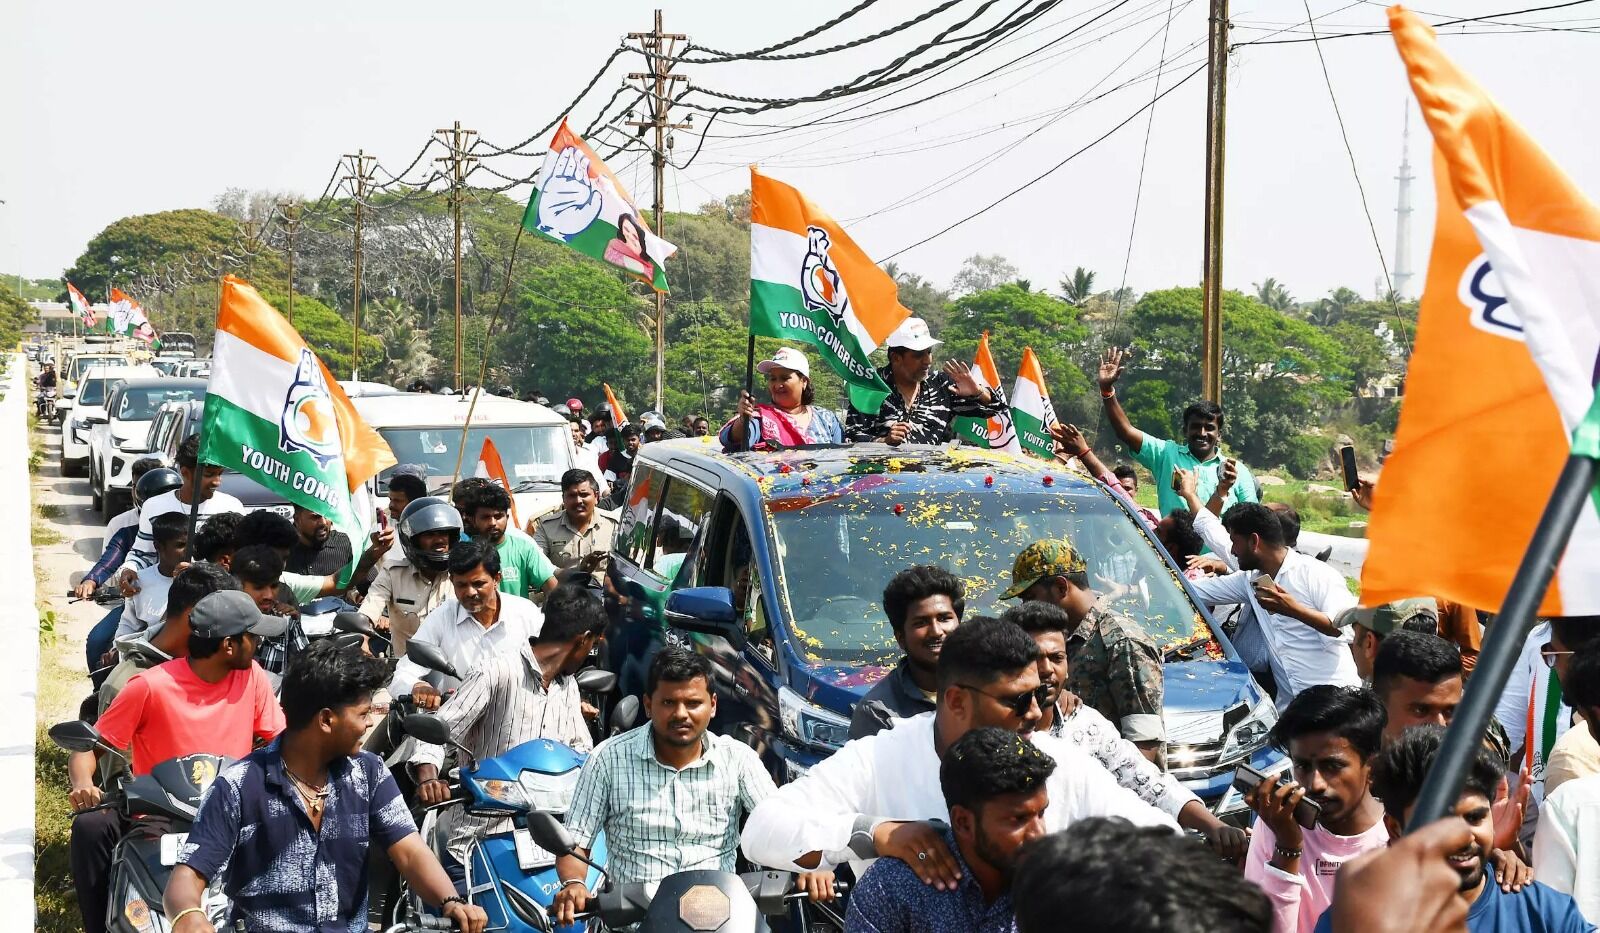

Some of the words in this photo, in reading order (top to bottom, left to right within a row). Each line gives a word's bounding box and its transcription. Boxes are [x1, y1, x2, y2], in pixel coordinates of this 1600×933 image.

[817, 326, 875, 380] CONGRESS
[1024, 431, 1045, 448] YOUTH
[242, 444, 290, 484] YOUTH
